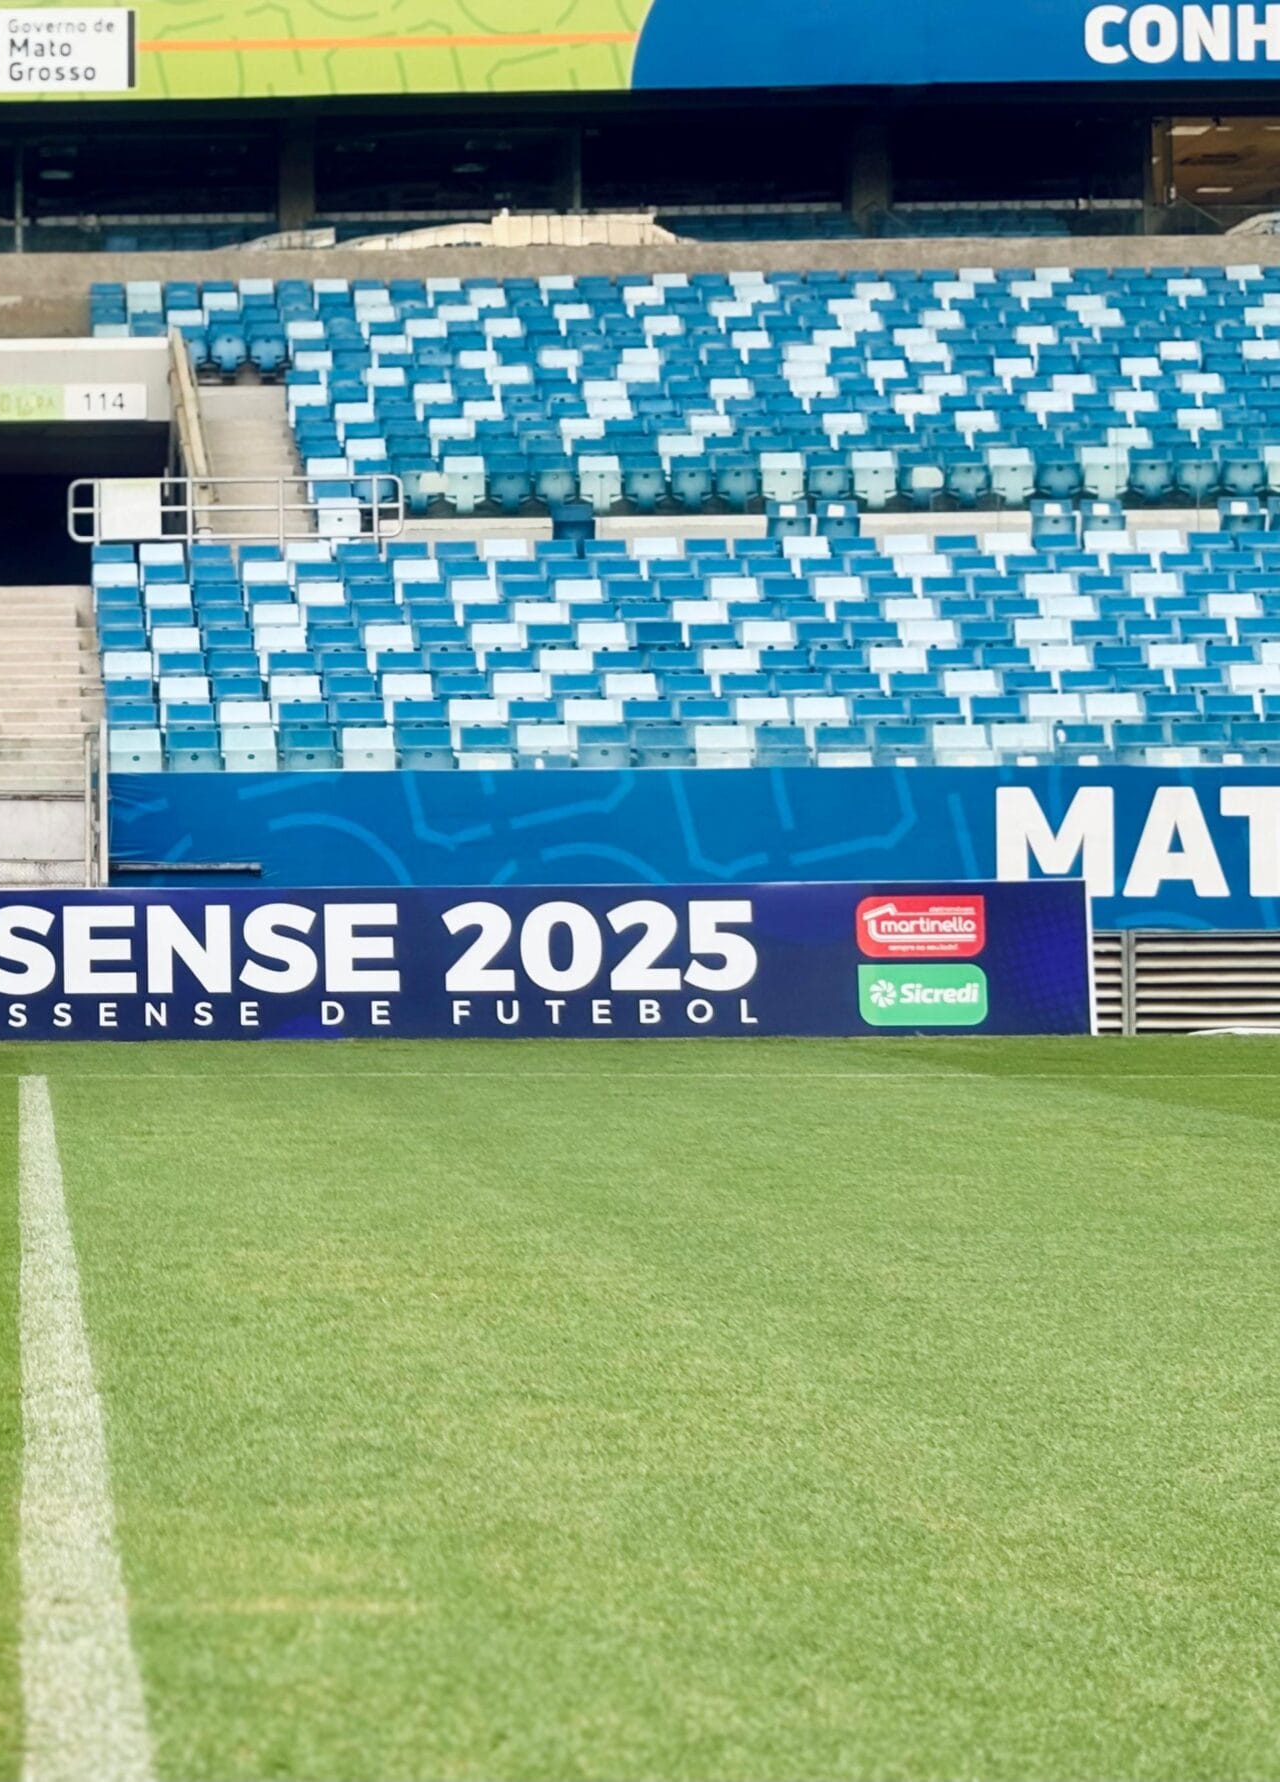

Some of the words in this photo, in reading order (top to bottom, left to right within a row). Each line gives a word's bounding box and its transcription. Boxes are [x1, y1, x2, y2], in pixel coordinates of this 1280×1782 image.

[8, 18, 87, 33] Governo
[94, 18, 115, 32] de
[1084, 4, 1280, 64] CONH
[9, 38, 73, 57] Mato
[9, 62, 97, 81] Grosso
[83, 392, 125, 411] 114
[995, 786, 1280, 898] MAT
[880, 916, 976, 934] martinello
[441, 900, 758, 992] 2025
[899, 982, 980, 1005] Sicredi
[322, 1001, 391, 1025] DE
[452, 999, 758, 1025] FUTEBOL
